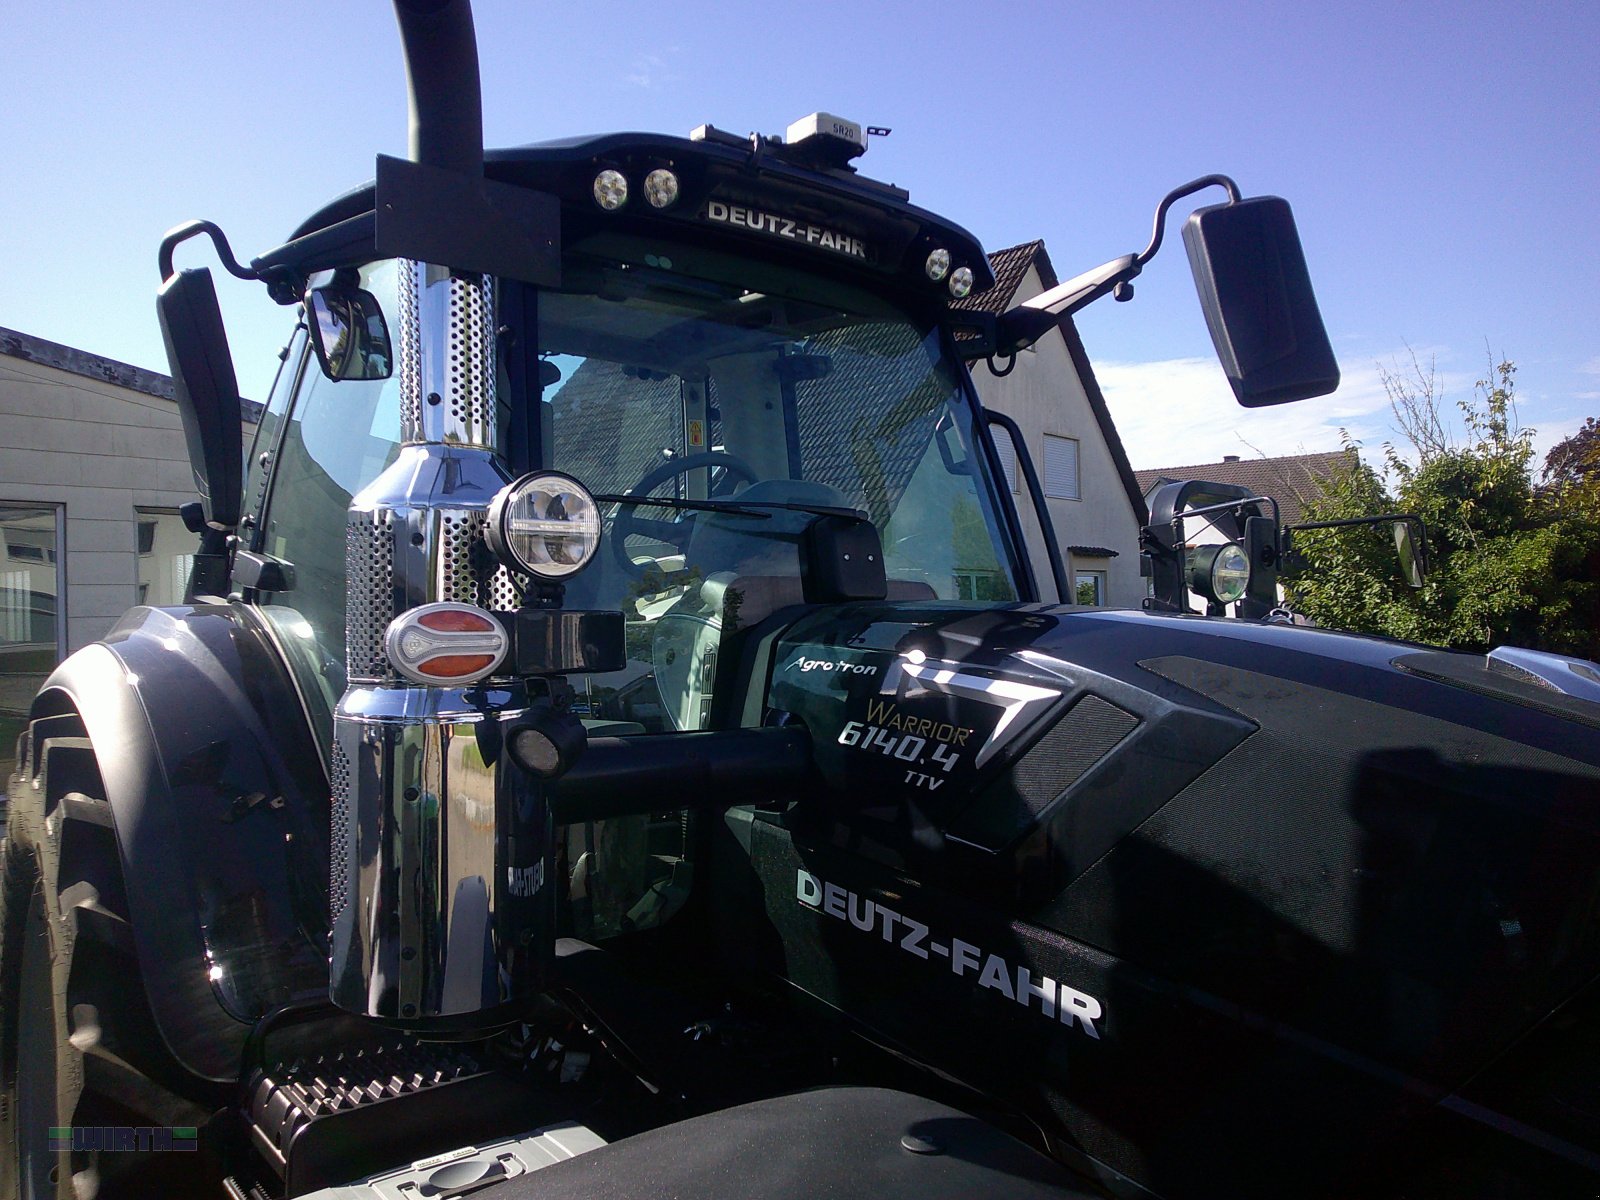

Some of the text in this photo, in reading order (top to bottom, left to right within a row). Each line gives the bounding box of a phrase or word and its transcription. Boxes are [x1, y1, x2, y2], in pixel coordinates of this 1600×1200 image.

[833, 123, 854, 138] SR20
[708, 201, 867, 258] DEUTZ-FAHR
[785, 656, 878, 676] Agrotron
[838, 721, 960, 773] 6140.4
[904, 770, 945, 791] TTV
[796, 868, 1103, 1040] DEUTZ-FAHR
